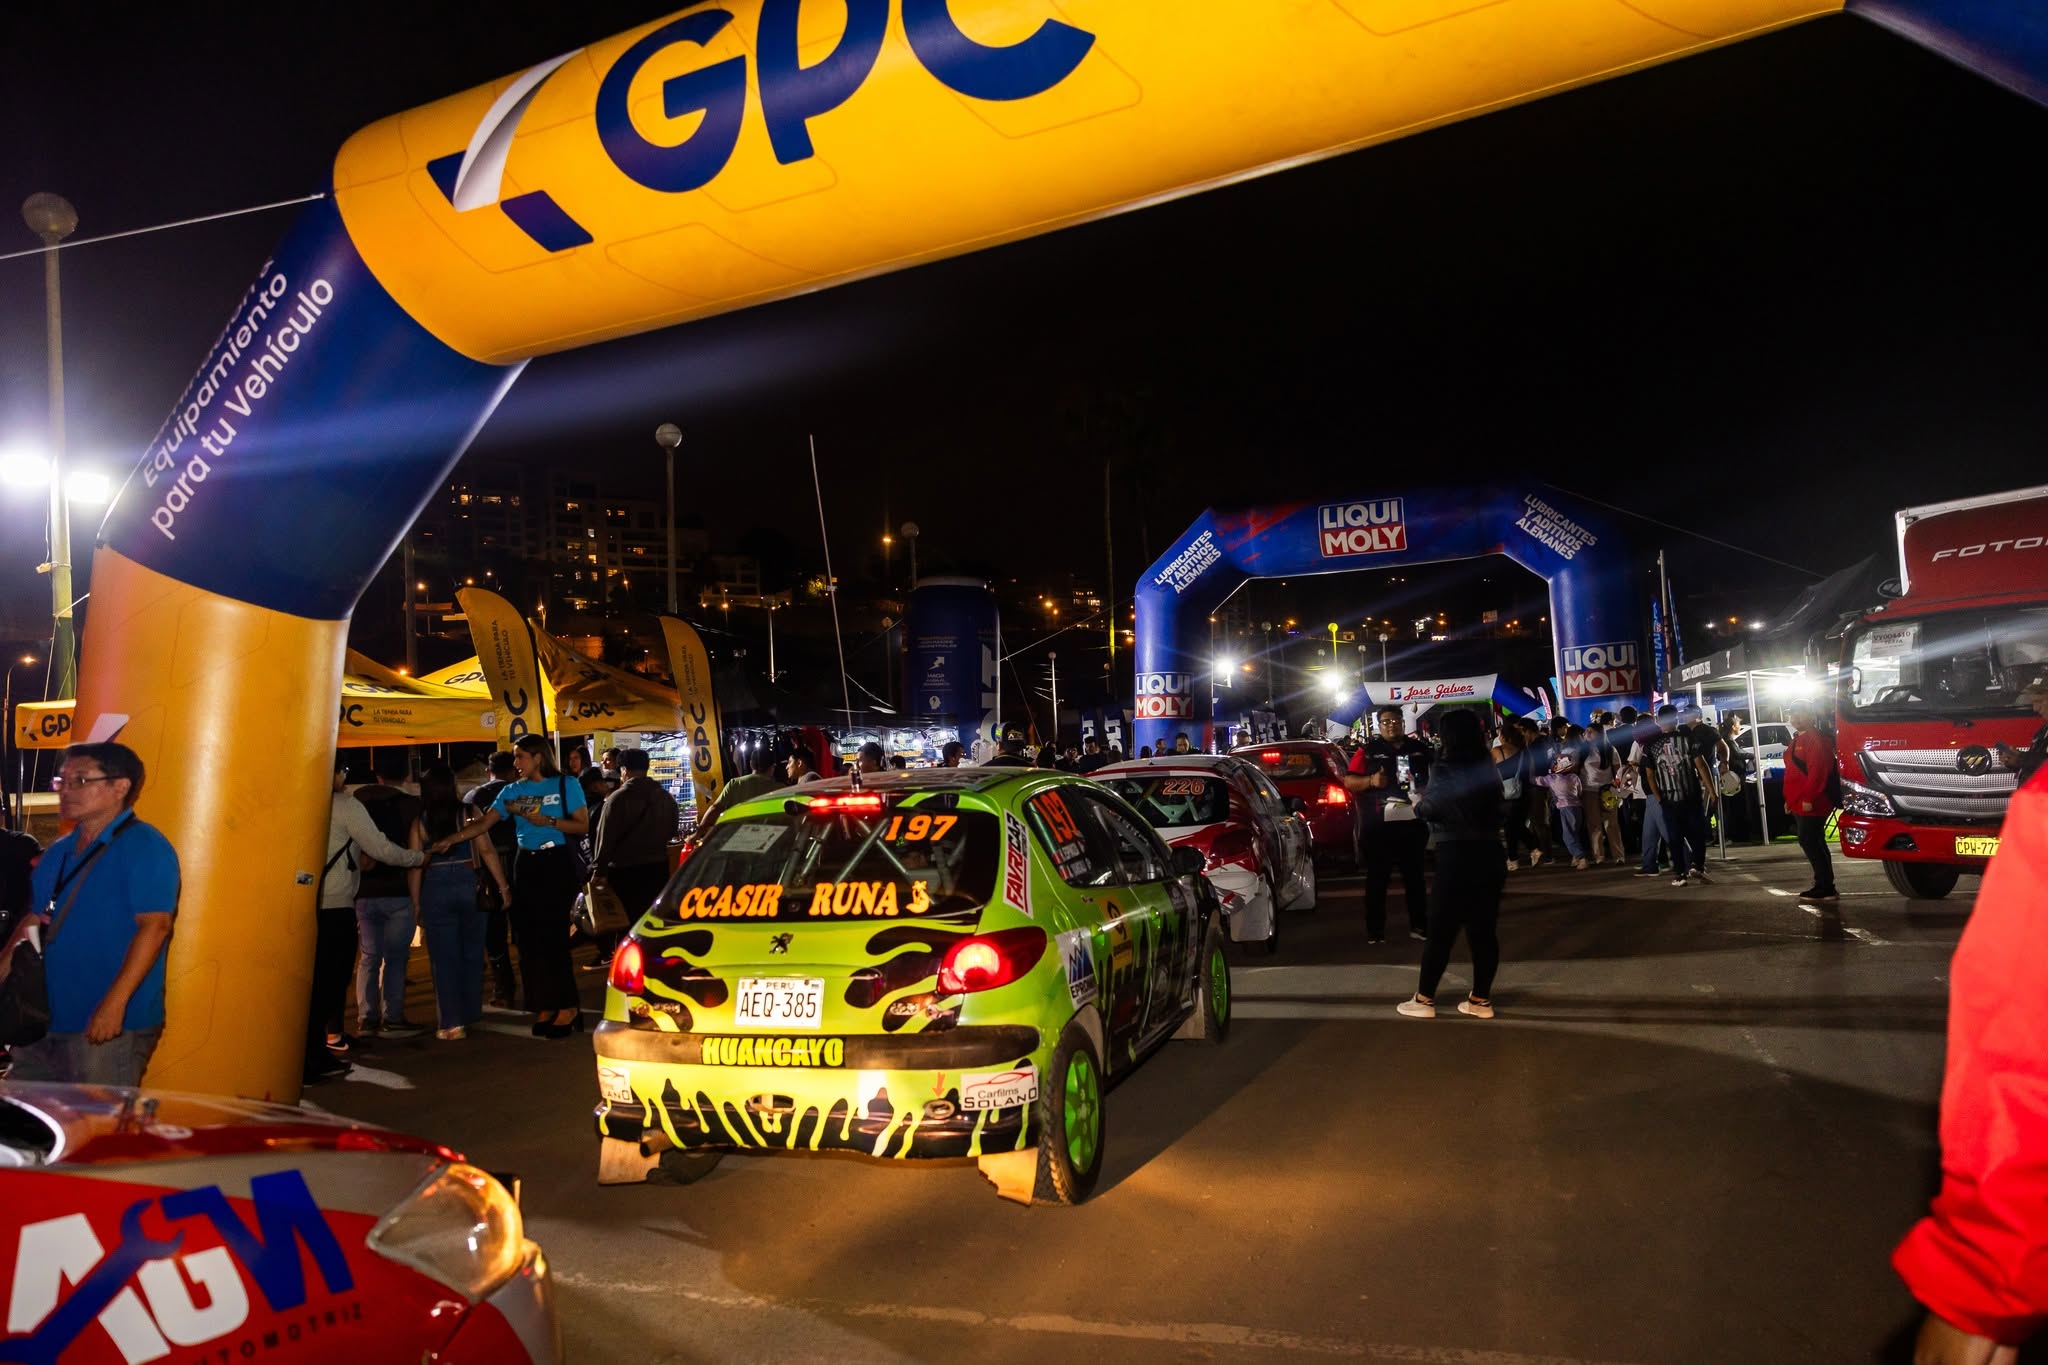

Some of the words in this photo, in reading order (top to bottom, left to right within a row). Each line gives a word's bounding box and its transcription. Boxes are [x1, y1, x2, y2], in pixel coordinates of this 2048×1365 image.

[596, 0, 1095, 193] GPC
[143, 273, 287, 488] Equipamiento
[151, 454, 211, 541] para
[201, 418, 237, 456] tu
[224, 278, 333, 417] Vehículo
[1323, 500, 1399, 529] LIQUI
[1524, 494, 1598, 547] LUBRICANTES
[1526, 506, 1536, 519] Y
[1534, 513, 1581, 551] ADITIVOS
[1324, 526, 1401, 555] MOLY
[1515, 517, 1576, 561] ALEMANES
[1932, 537, 2048, 562] FOTO
[1154, 530, 1212, 585] LUBRICANTES
[1165, 576, 1176, 587] Y
[1174, 541, 1214, 581] ADITIVOS
[1174, 548, 1222, 594] ALEMANES
[1564, 645, 1634, 671] LIQUI
[1136, 675, 1190, 695] LIQUI
[1404, 685, 1430, 700] José
[1566, 669, 1637, 696] MOLY
[504, 688, 529, 744] PC
[578, 702, 614, 718] GPC
[1136, 696, 1191, 717] MOLY
[42, 714, 71, 737] GP
[690, 703, 712, 772] GPC
[1163, 779, 1205, 795] 226
[885, 815, 958, 841] 197
[680, 884, 783, 919] CCASIR
[808, 881, 899, 916] RUNA
[766, 982, 795, 990] PERU
[740, 992, 817, 1018] AEQ-385
[702, 1037, 844, 1066] HUANCAYO
[964, 1087, 1037, 1108] SOLANO
[978, 1088, 1019, 1099] Carfilms
